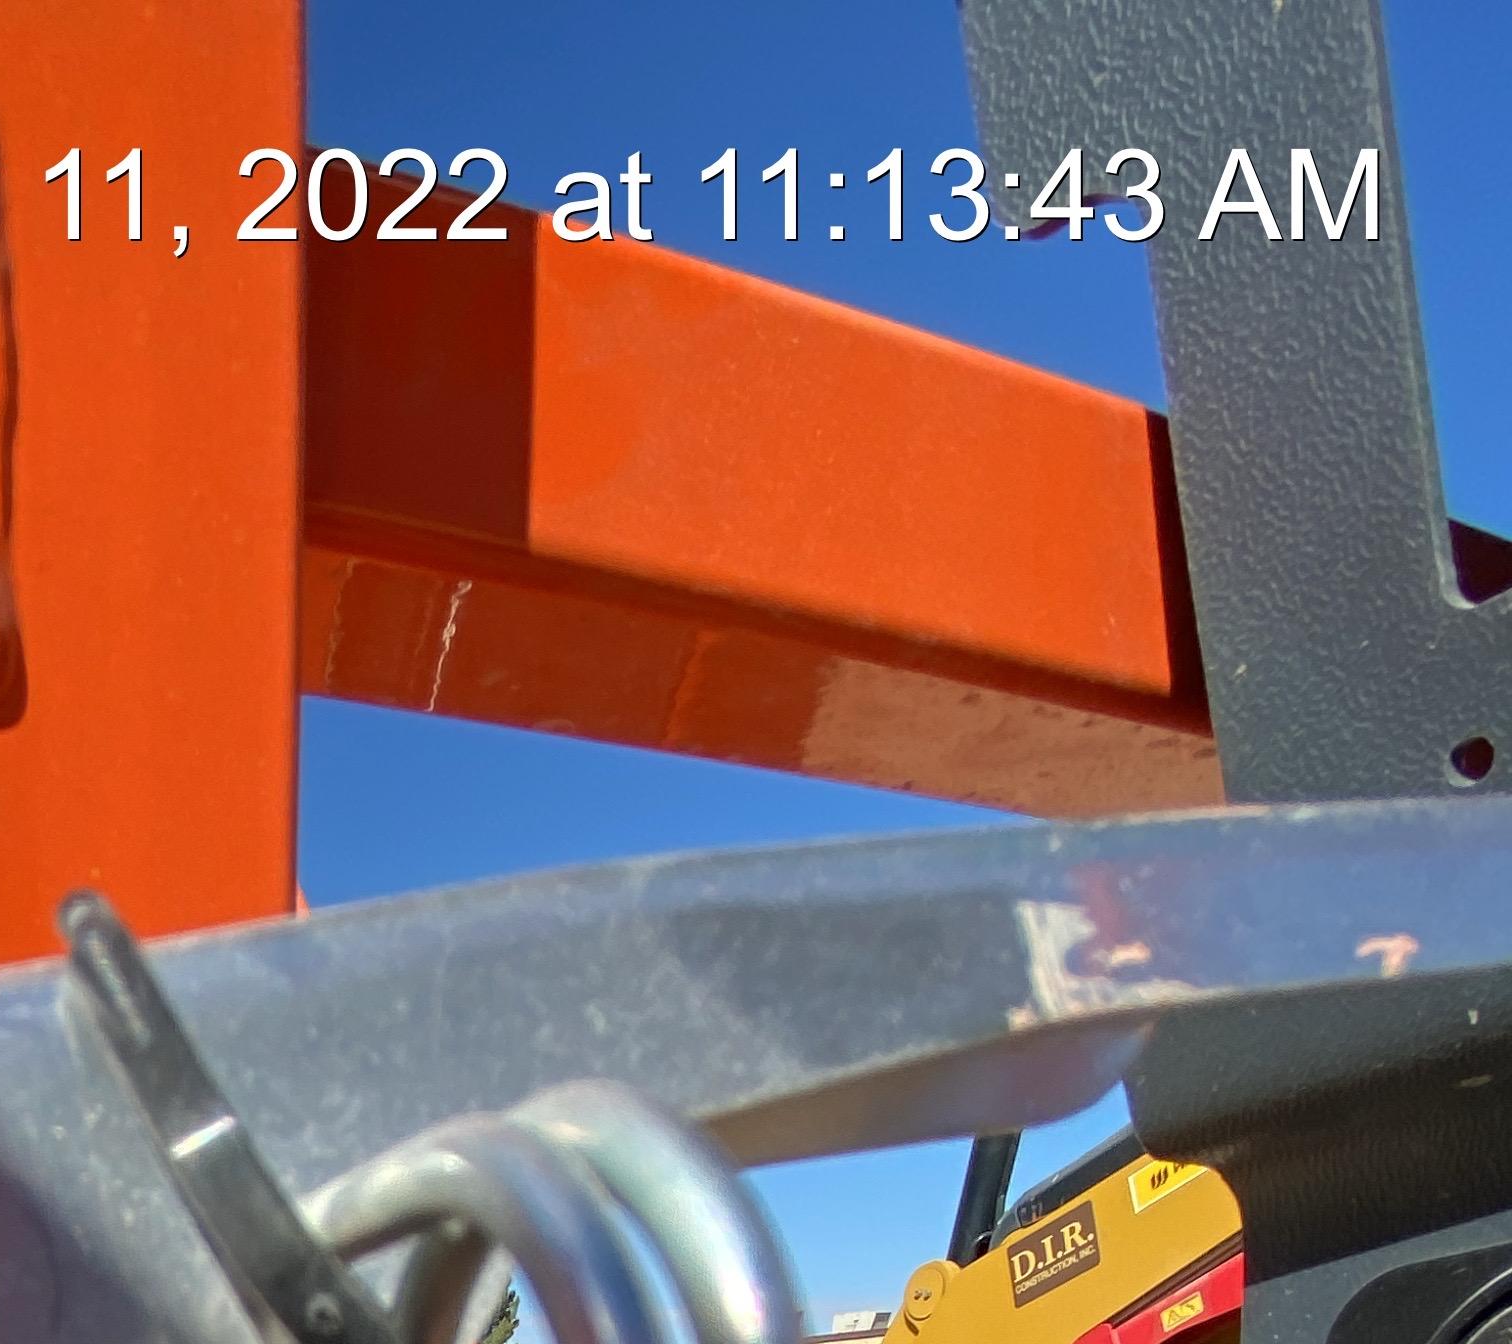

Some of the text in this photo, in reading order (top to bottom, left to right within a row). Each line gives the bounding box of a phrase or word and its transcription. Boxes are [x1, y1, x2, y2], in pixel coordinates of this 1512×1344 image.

[1010, 1221, 1095, 1284] D.I.R.
[1015, 1244, 1096, 1295] CONSTRUCTION, INC.
